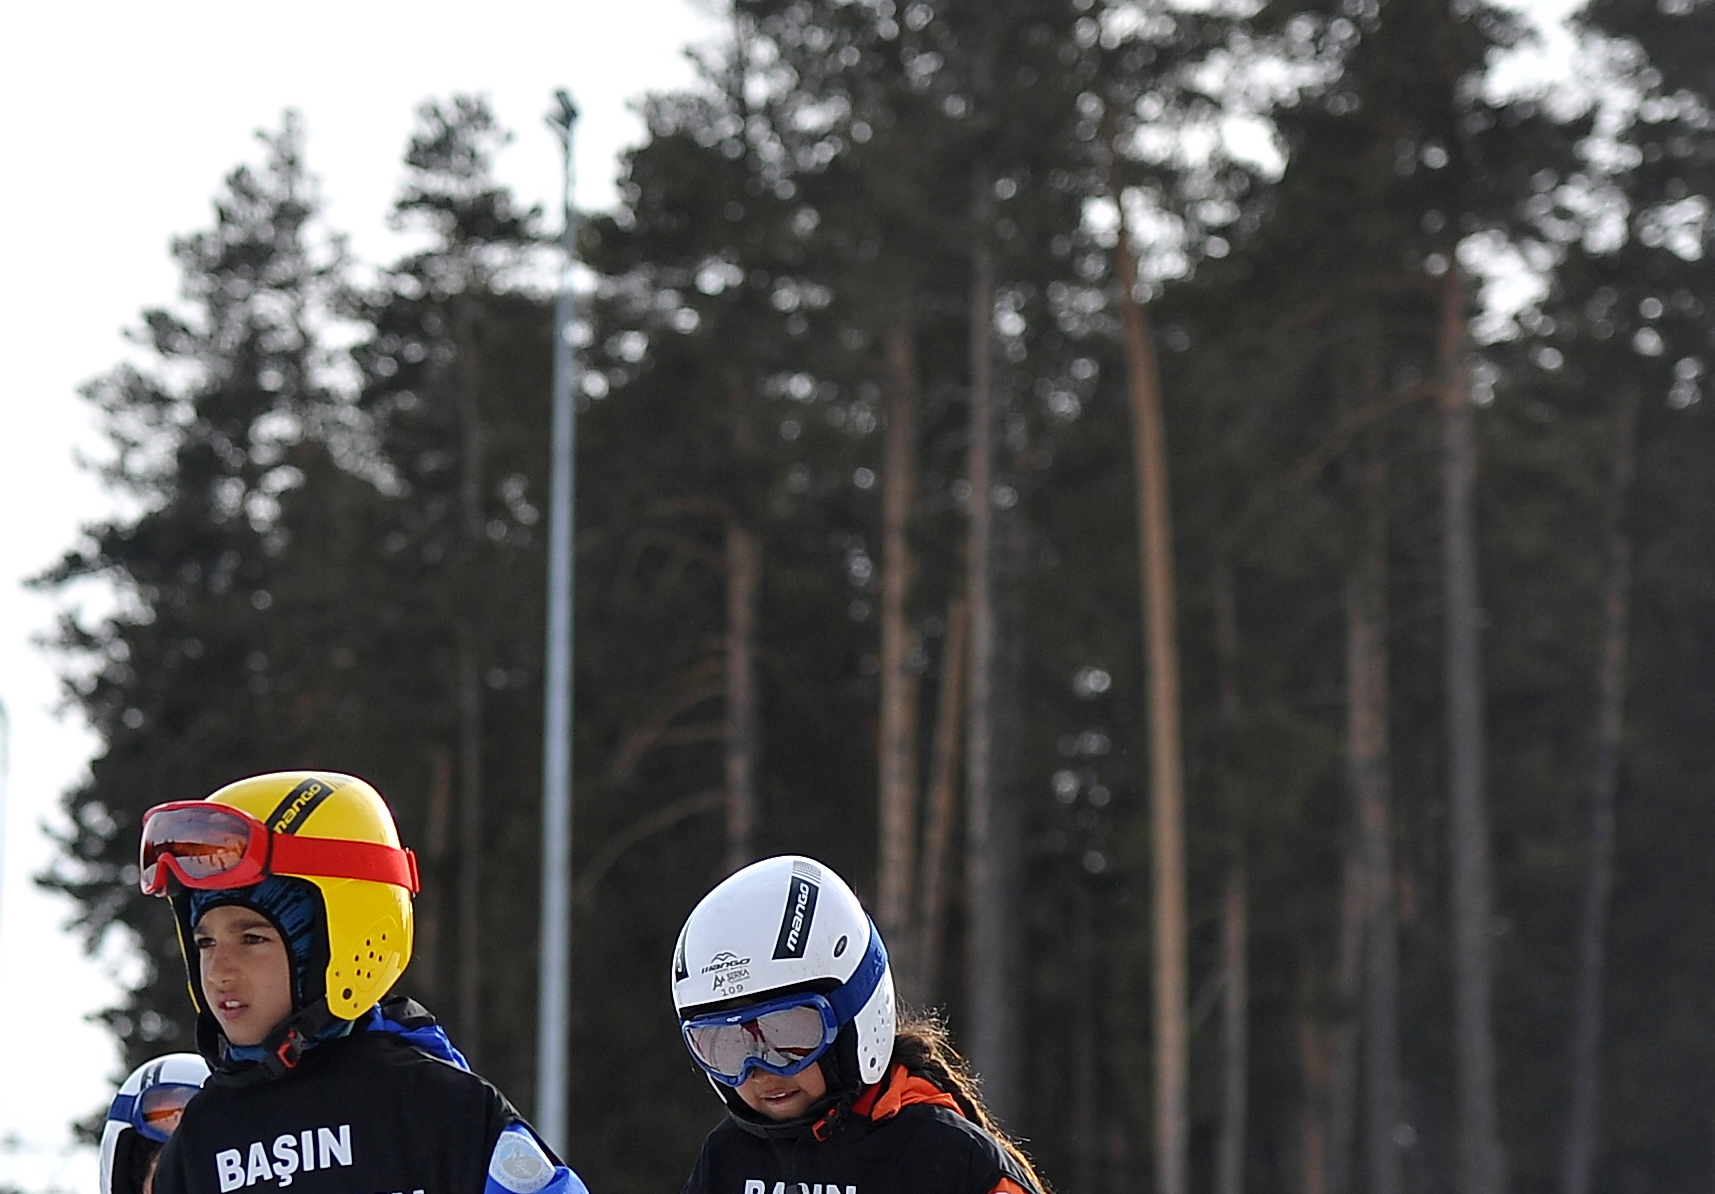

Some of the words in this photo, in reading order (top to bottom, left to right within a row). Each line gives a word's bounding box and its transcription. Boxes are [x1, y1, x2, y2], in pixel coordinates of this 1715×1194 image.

[786, 882, 810, 953] mango
[721, 984, 744, 997] 109
[215, 1124, 353, 1194] BAŞIN
